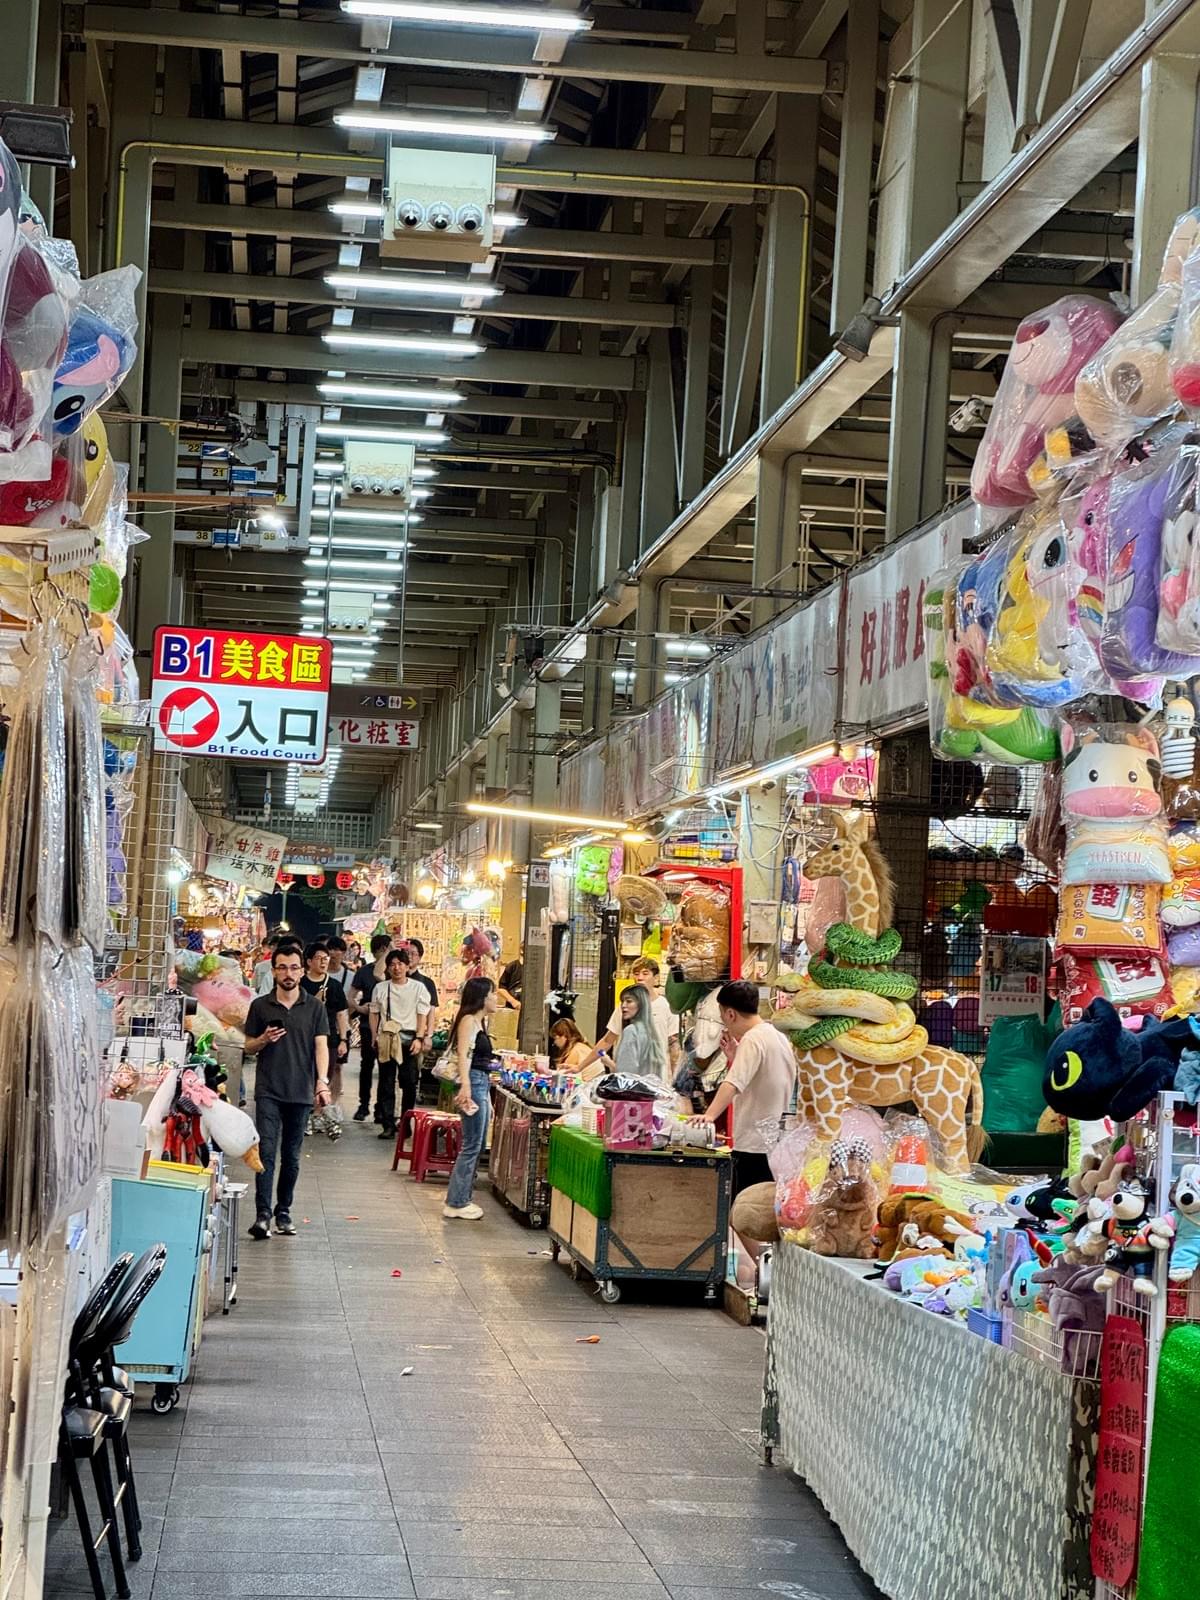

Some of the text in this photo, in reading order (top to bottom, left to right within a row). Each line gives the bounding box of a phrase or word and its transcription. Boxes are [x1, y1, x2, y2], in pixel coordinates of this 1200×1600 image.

[212, 468, 224, 476] 21
[196, 531, 208, 540] 38
[263, 532, 275, 540] 39
[220, 638, 323, 683] 美食區
[225, 699, 318, 746] 入口
[338, 718, 415, 746] 化粧室
[208, 744, 318, 760] B1 Food Court
